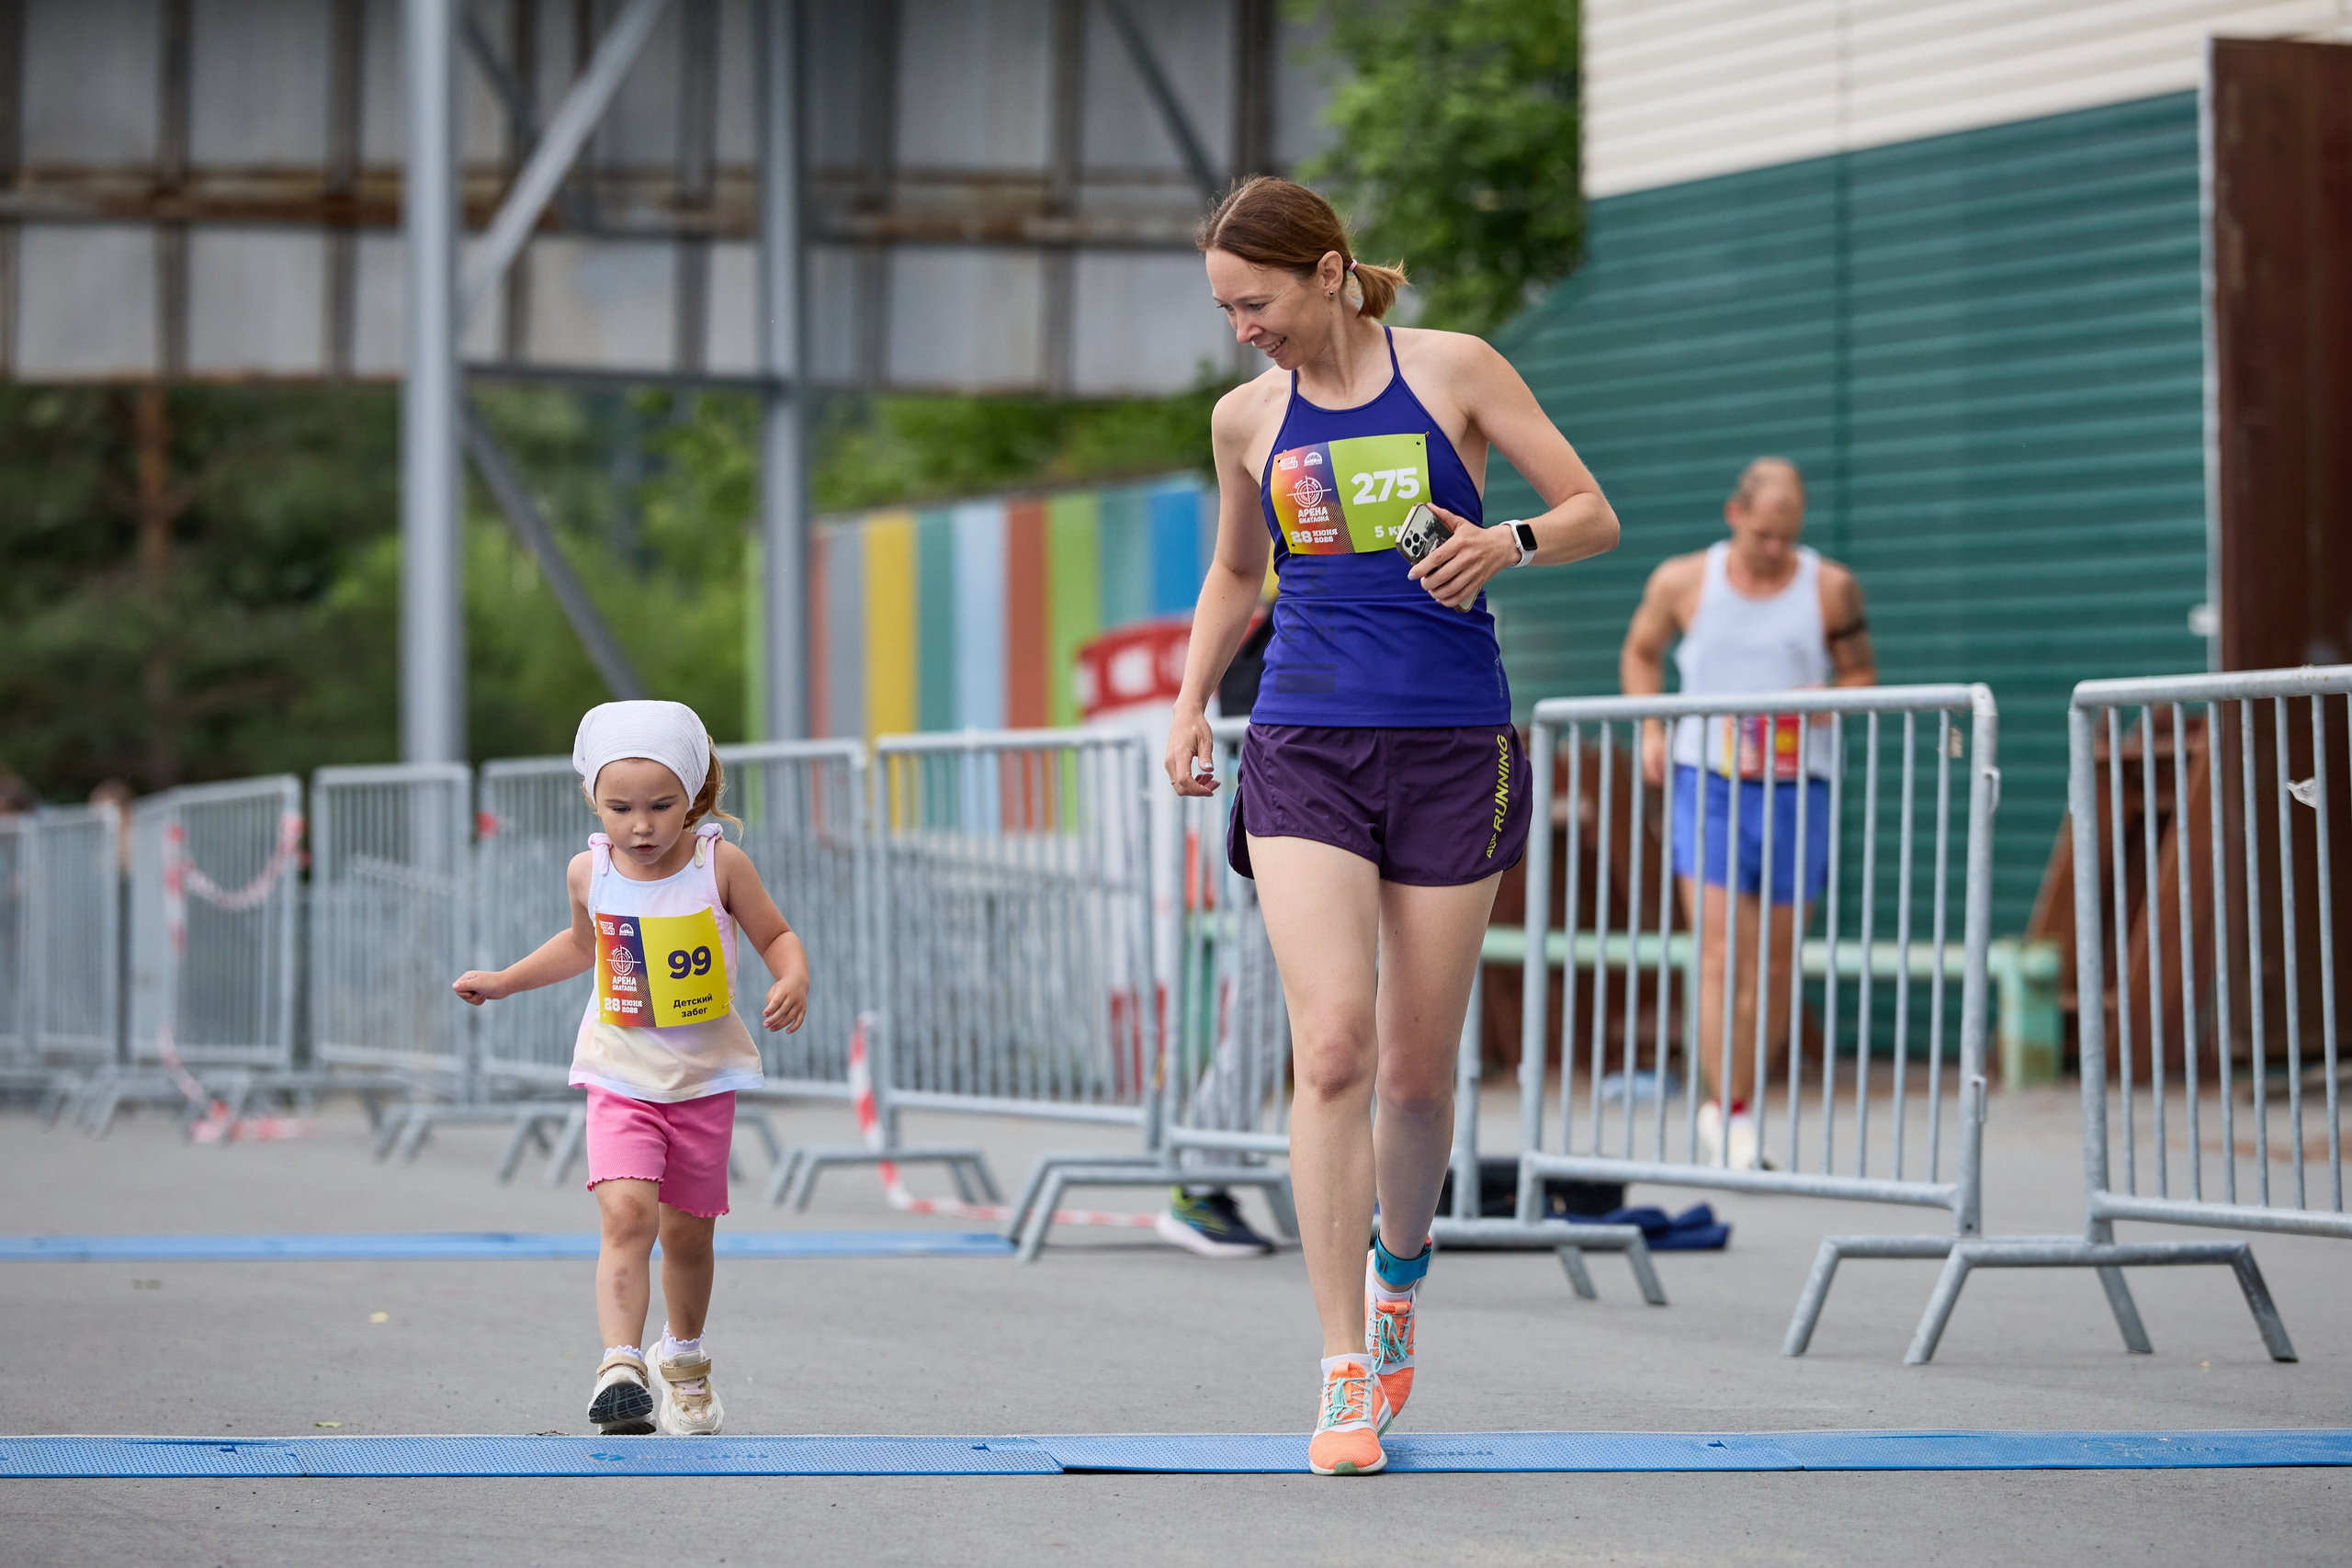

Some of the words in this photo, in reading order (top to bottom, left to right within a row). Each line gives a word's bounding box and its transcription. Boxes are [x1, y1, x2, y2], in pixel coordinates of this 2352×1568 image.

[1351, 467, 1420, 505] 275
[1297, 506, 1329, 519] АРЕНА
[1298, 514, 1330, 525] БИАТЛОНА
[1290, 530, 1313, 544] 28
[1313, 528, 1339, 537] ИЮНЯ
[1374, 525, 1385, 538] 5
[1493, 734, 1510, 833] RUNNING
[667, 945, 712, 980] 99
[612, 976, 637, 986] АРЕНА
[604, 997, 621, 1012] 28
[621, 998, 643, 1008] ИЮНЯ
[673, 993, 713, 1010] Детский
[681, 1006, 708, 1018] забег
